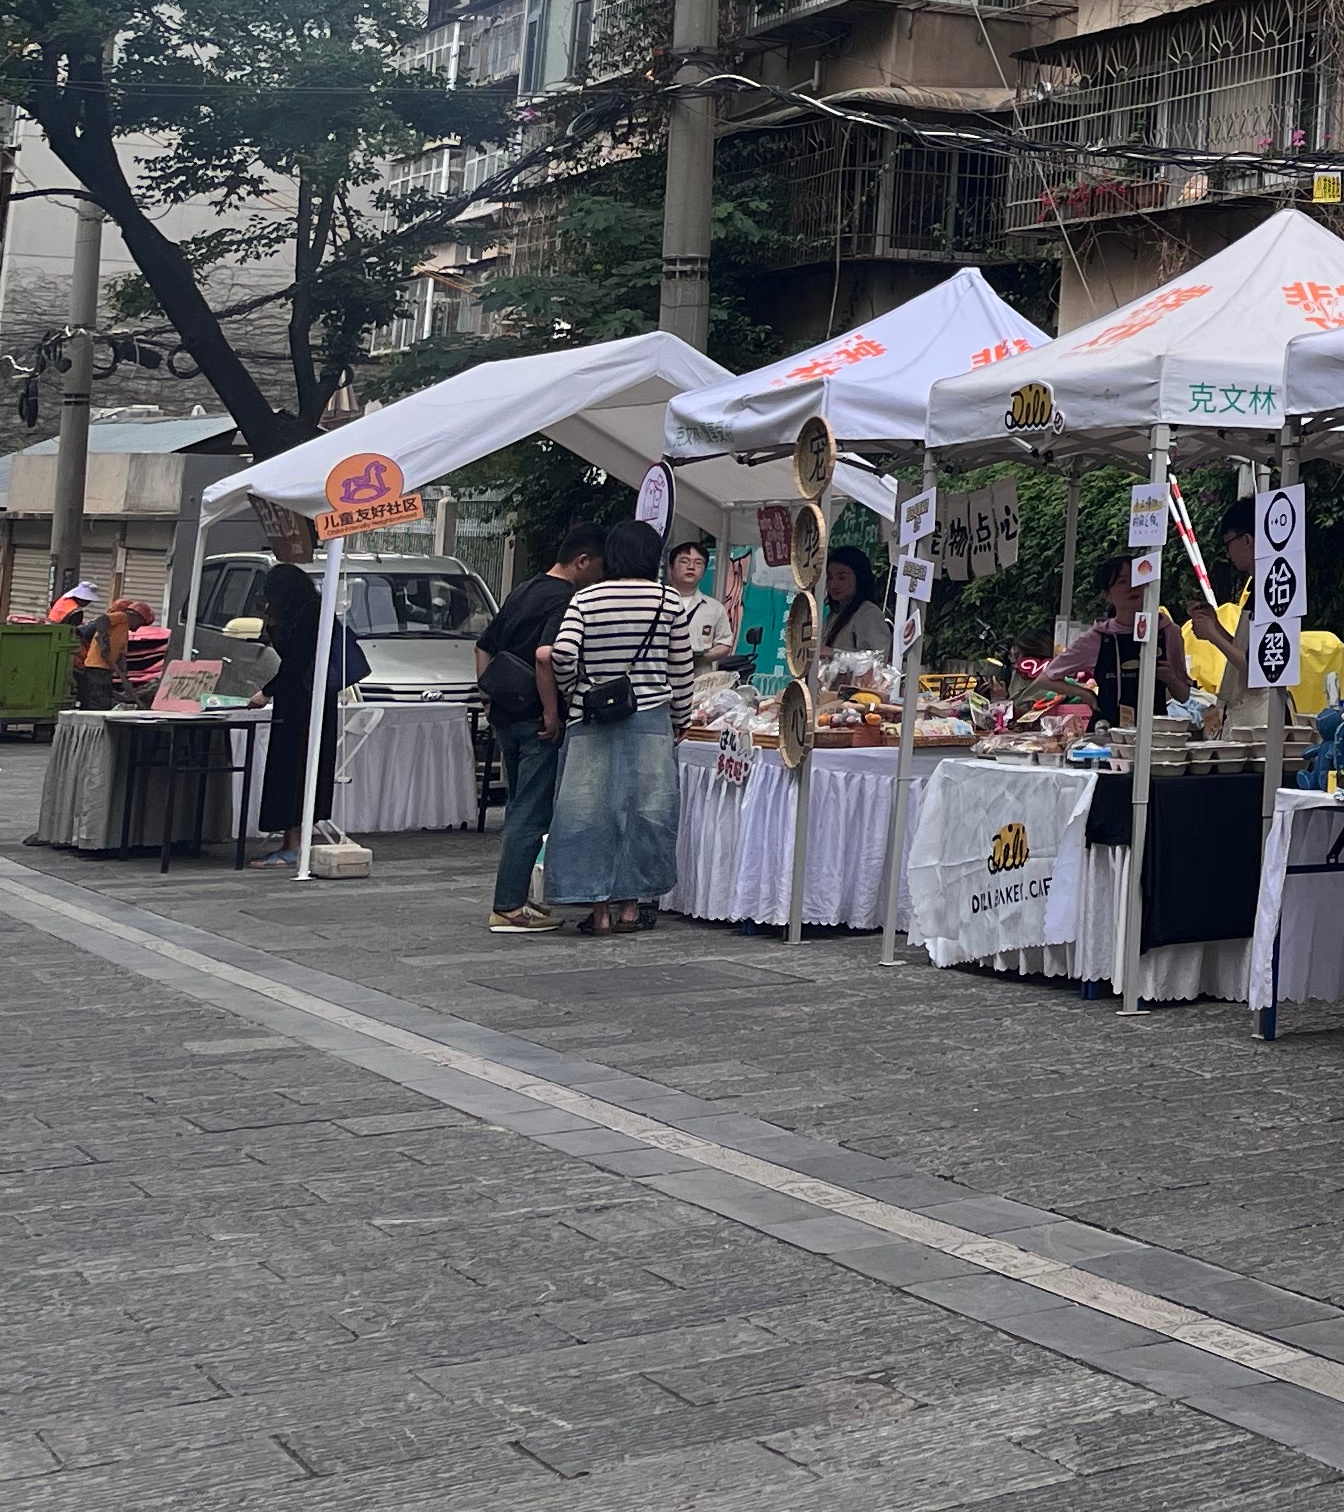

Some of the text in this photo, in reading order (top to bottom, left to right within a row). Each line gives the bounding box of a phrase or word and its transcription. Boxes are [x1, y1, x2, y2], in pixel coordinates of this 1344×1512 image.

[1188, 381, 1277, 416] 克文林
[324, 497, 418, 531] 儿童友好社区
[1263, 562, 1293, 672] 拾翠
